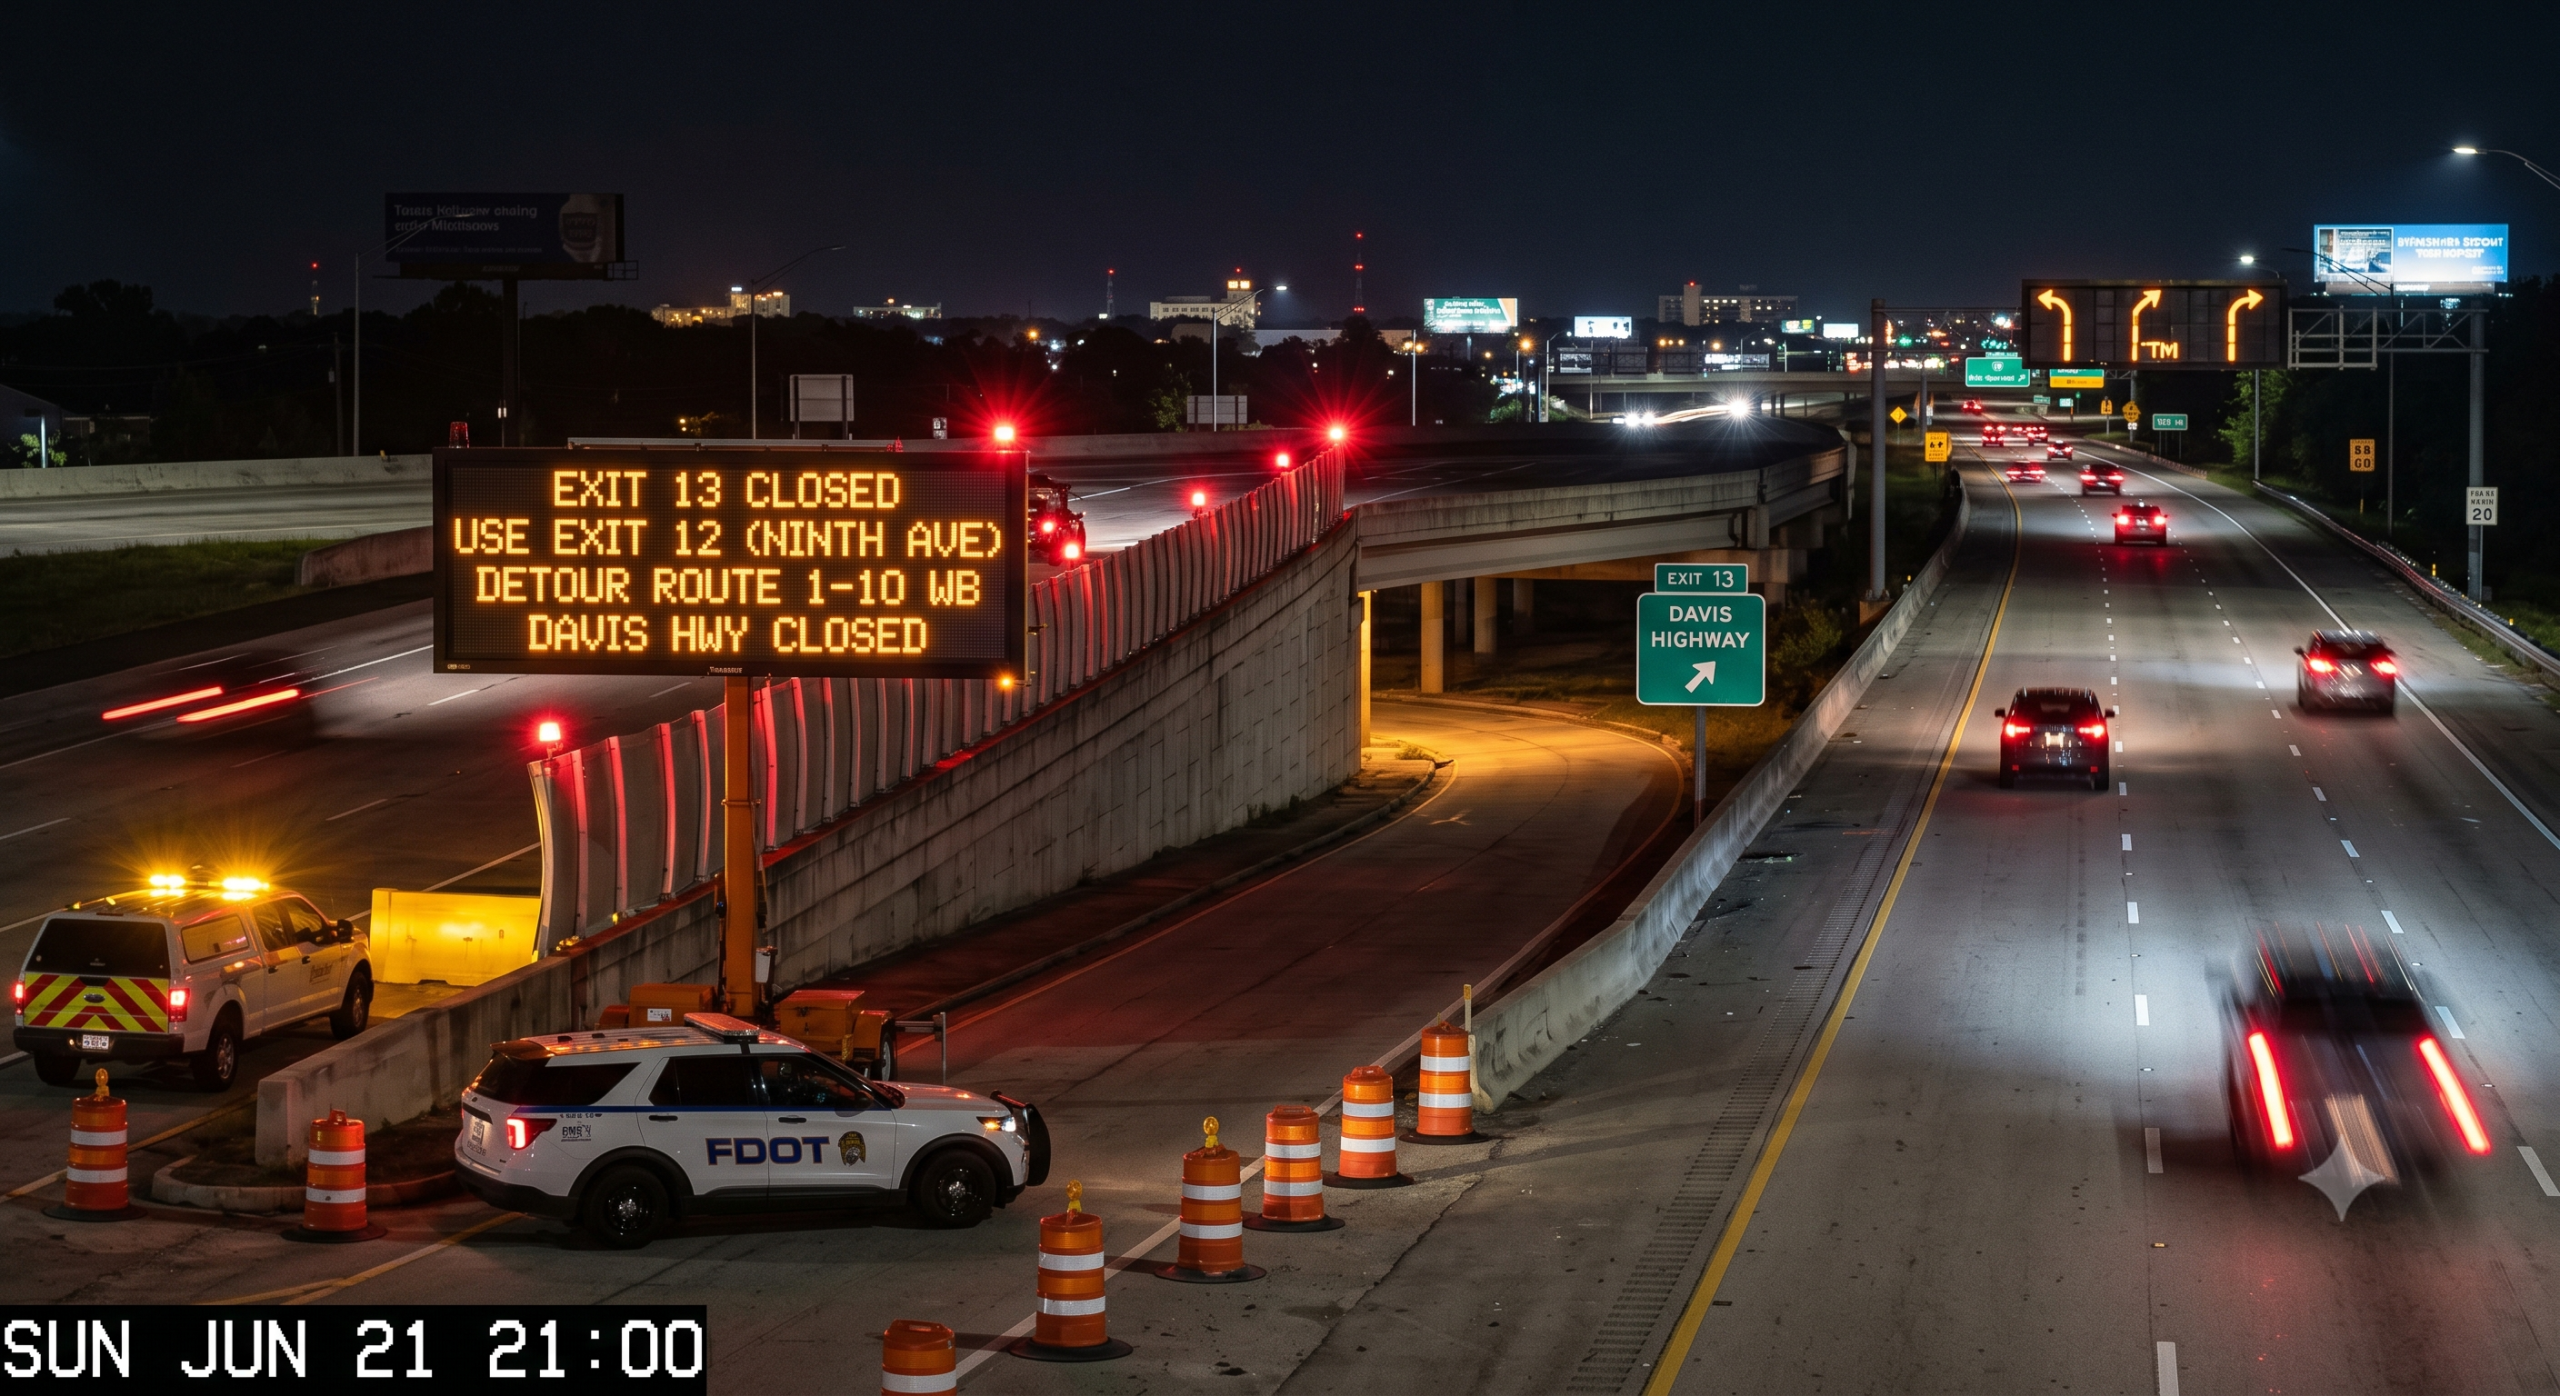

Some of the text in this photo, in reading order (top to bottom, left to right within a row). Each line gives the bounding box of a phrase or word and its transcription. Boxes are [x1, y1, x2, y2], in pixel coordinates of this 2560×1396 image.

[554, 470, 900, 509] EXIT 13 CLOSED
[2472, 507, 2493, 521] 20
[454, 518, 1001, 558] USE EXIT 12 (NINTH AVE)
[476, 566, 980, 606] DETOUR ROUTE 1-10 WB
[1667, 570, 1734, 588] EXIT 13
[1669, 605, 1733, 623] DAVIS
[528, 614, 927, 654] DAVIS HWY CLOSED
[1651, 631, 1750, 649] HIGHWAY
[705, 1136, 830, 1166] FDOT
